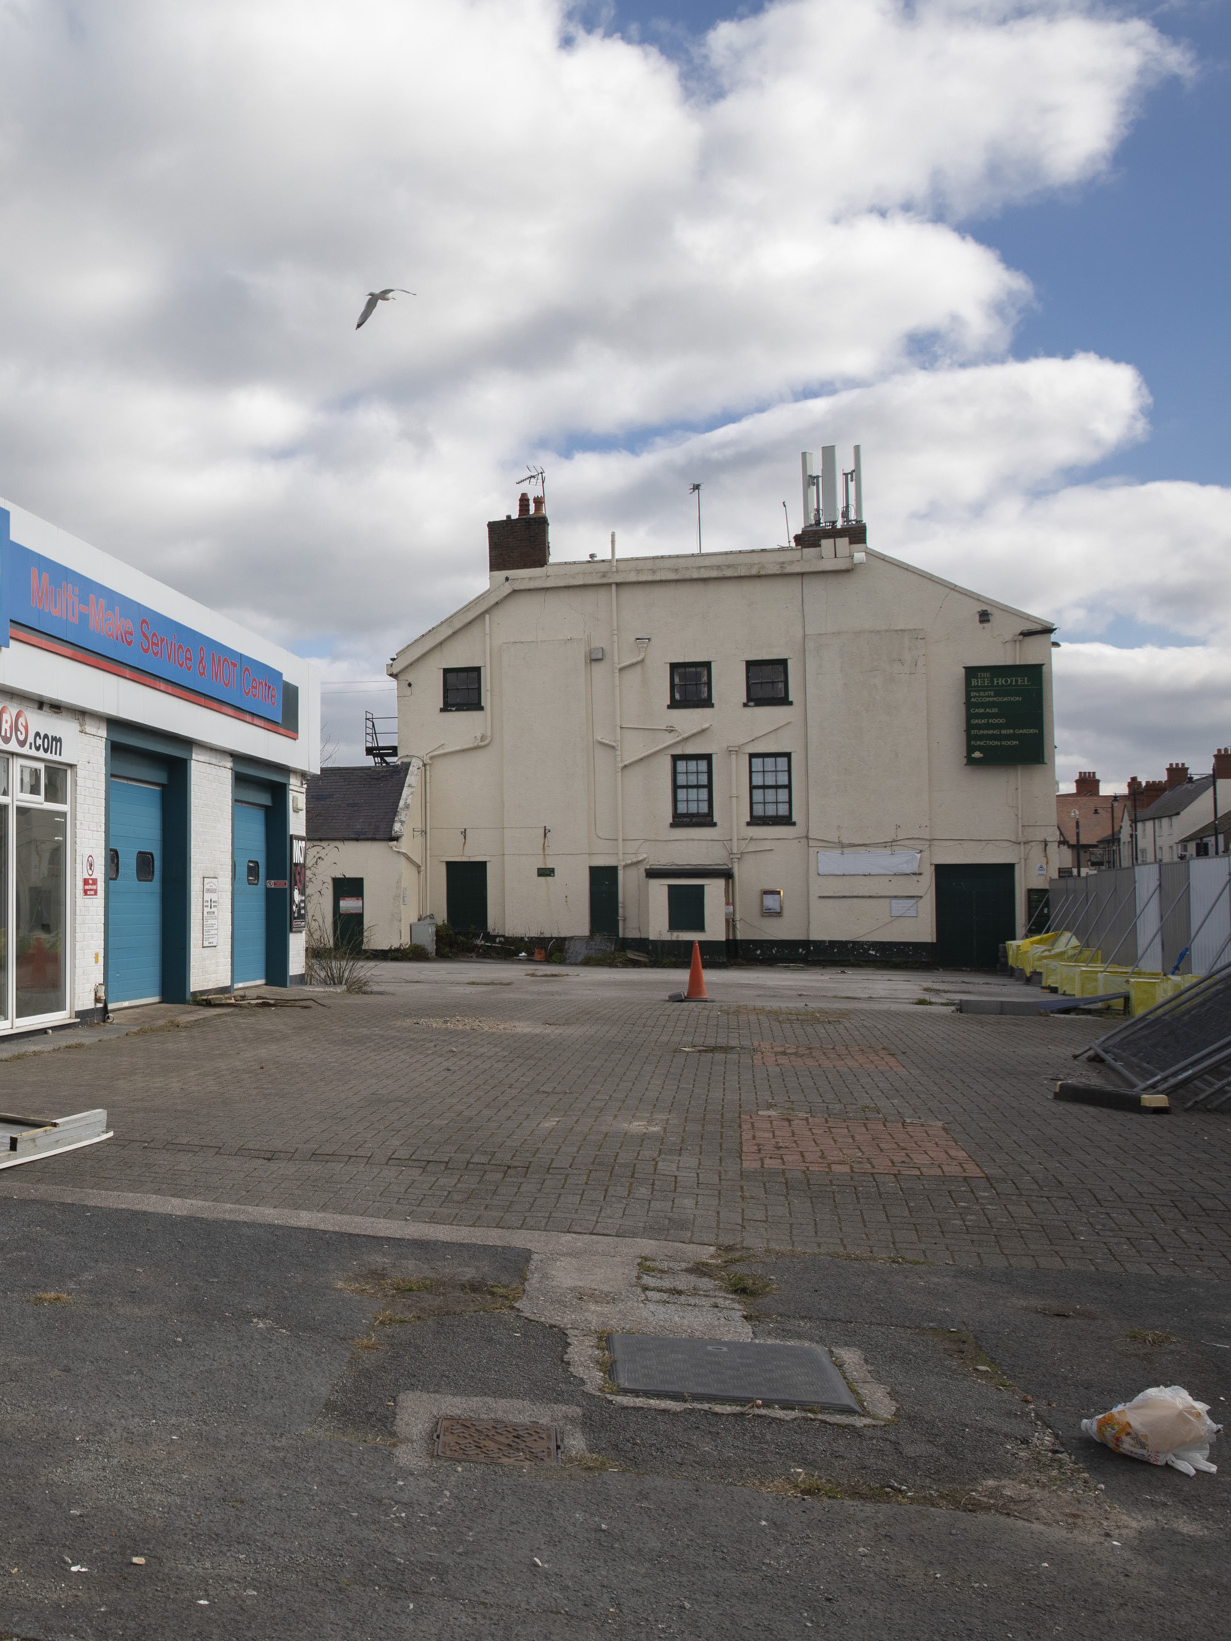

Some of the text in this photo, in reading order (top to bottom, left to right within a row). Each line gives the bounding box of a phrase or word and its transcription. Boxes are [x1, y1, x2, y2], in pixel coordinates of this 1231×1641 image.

[30, 567, 277, 707] Multi-Make Service & MOT Centre
[971, 677, 1031, 686] BEE HOTEL
